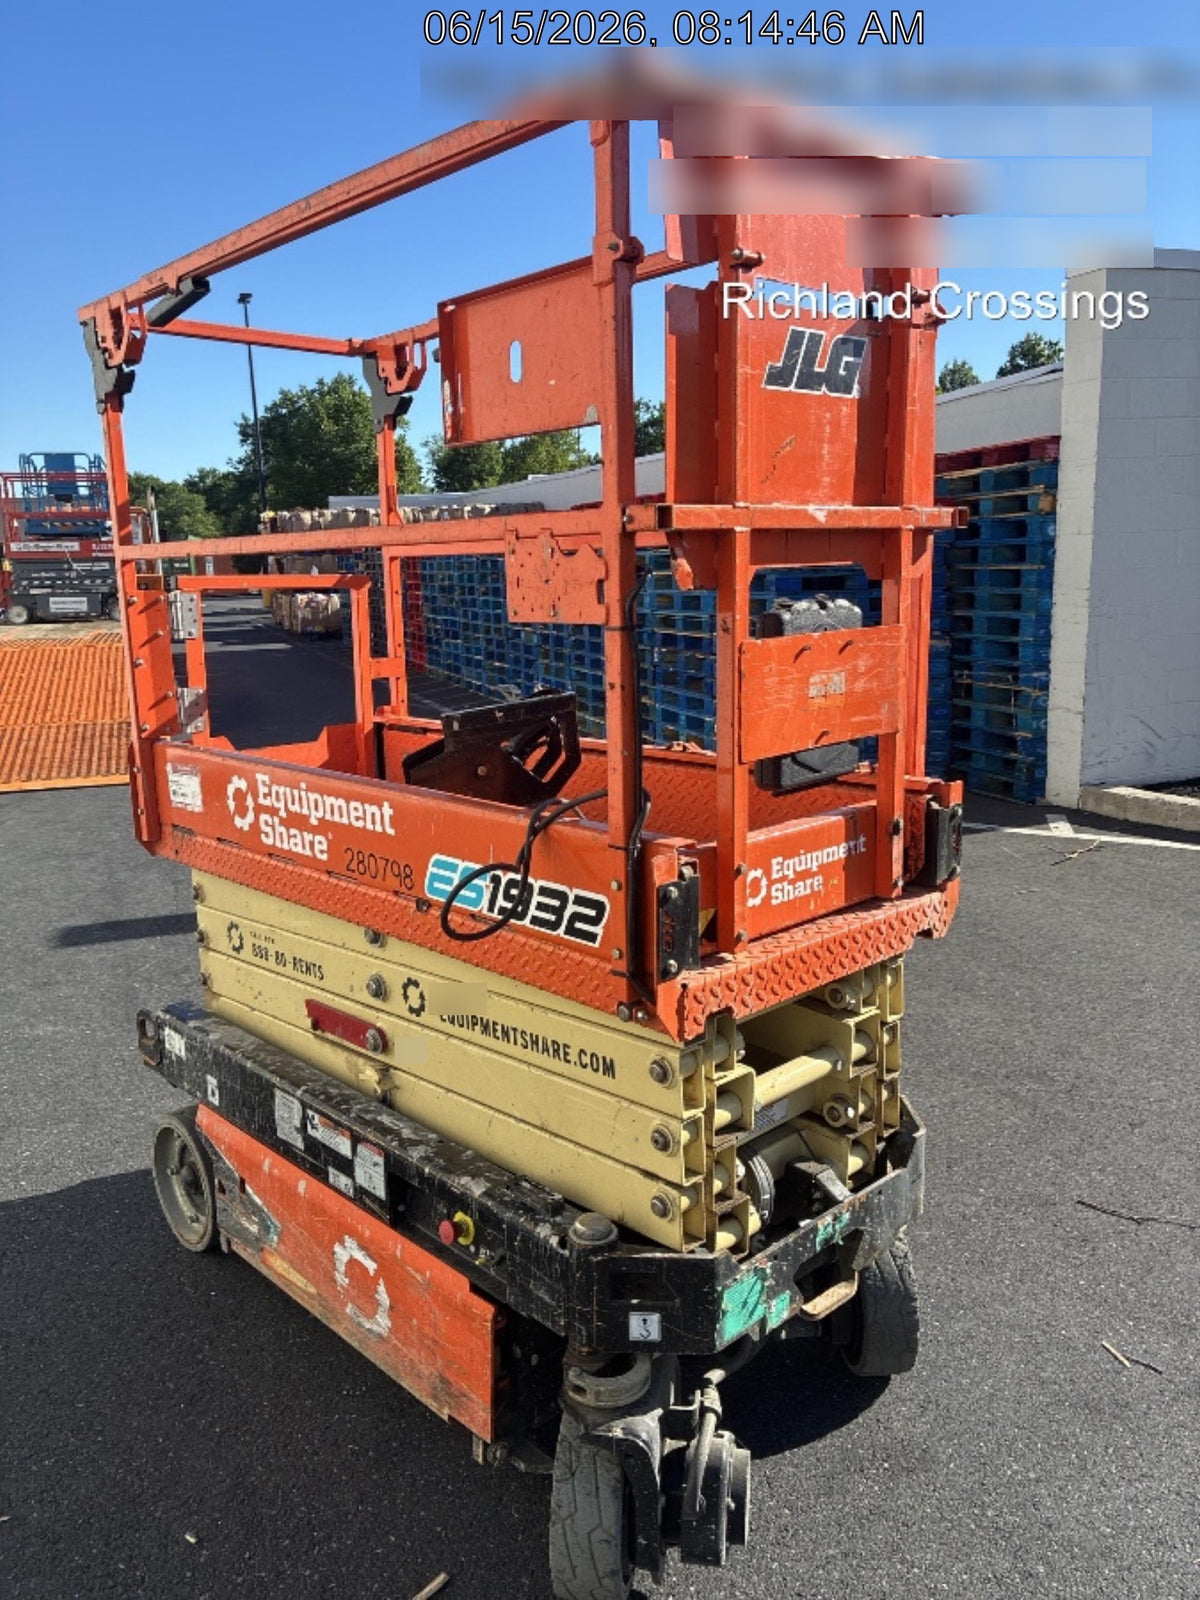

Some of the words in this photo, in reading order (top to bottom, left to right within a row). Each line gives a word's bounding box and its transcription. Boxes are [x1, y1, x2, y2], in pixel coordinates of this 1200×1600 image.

[761, 325, 868, 399] JLG
[255, 772, 396, 836] Equipment
[258, 812, 329, 862] Share
[770, 833, 867, 880] Equipment
[344, 846, 415, 891] 280798
[770, 873, 824, 907] Share
